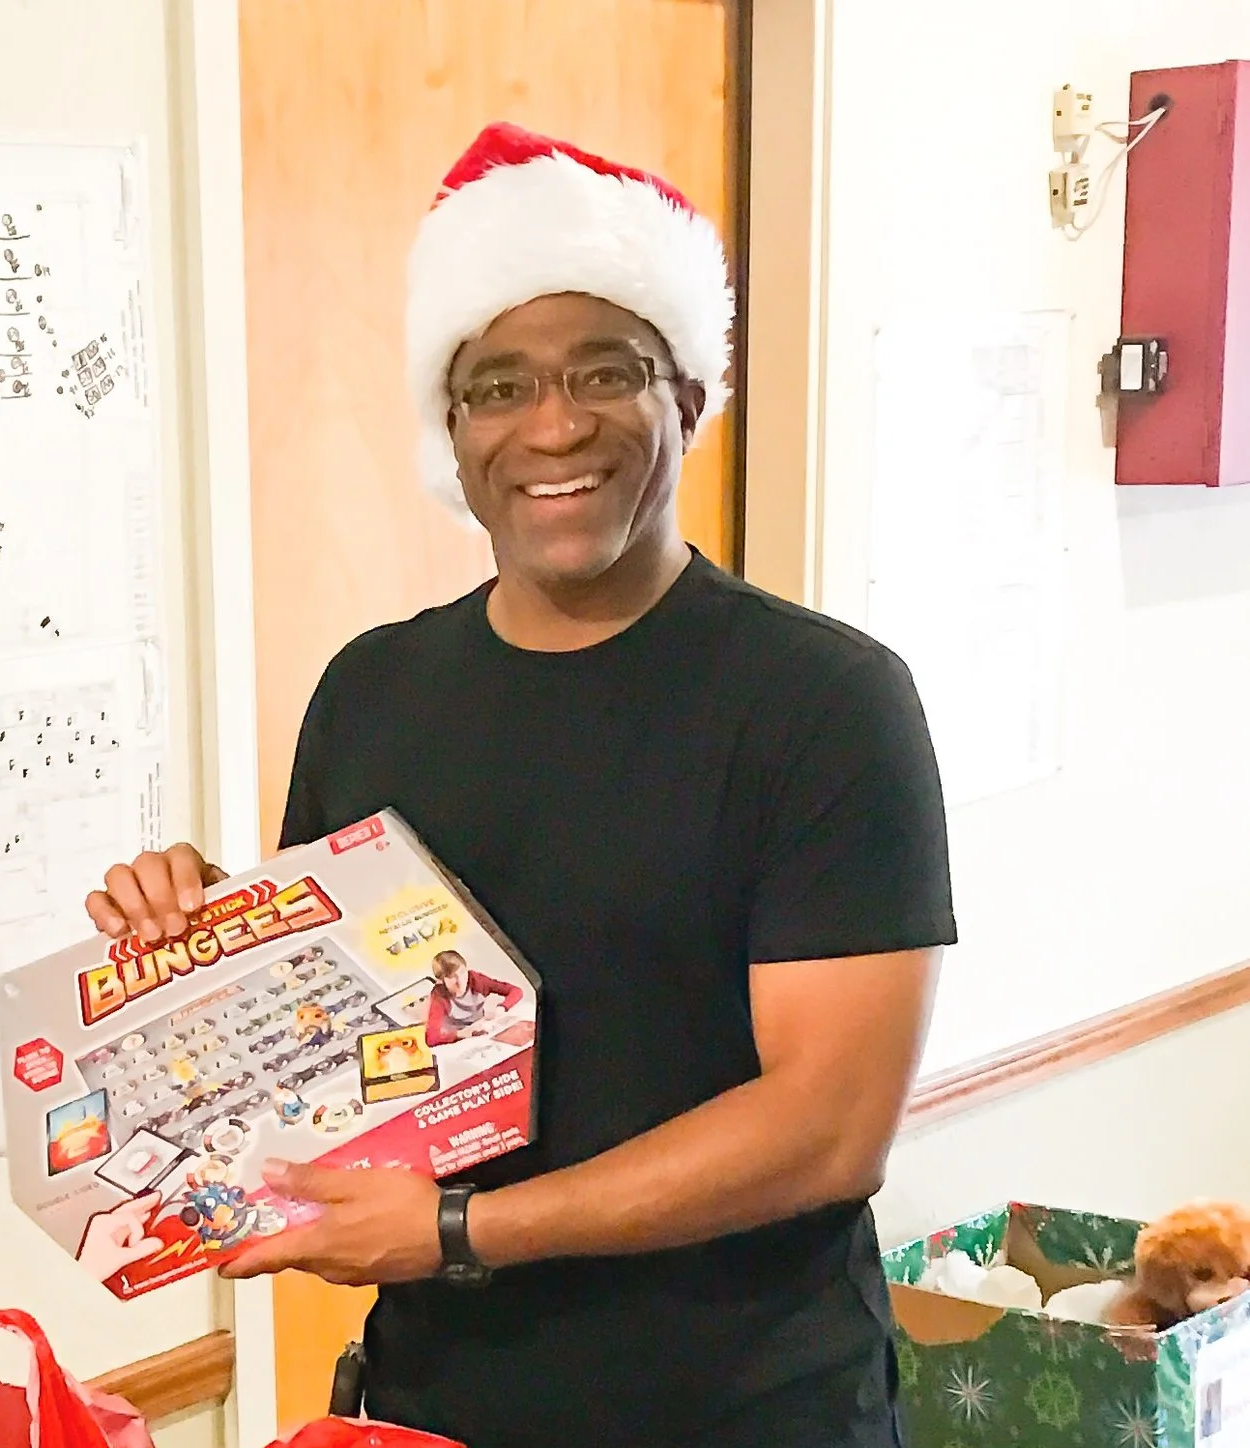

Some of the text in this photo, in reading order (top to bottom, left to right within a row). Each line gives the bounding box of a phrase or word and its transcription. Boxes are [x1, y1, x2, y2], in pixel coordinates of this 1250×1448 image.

[202, 896, 247, 923] STICK
[79, 876, 343, 1026] BUNGEES
[413, 1069, 520, 1118] COLLECTOR'S SIDE
[427, 1104, 462, 1125] GAME
[461, 1093, 491, 1111] PLAY
